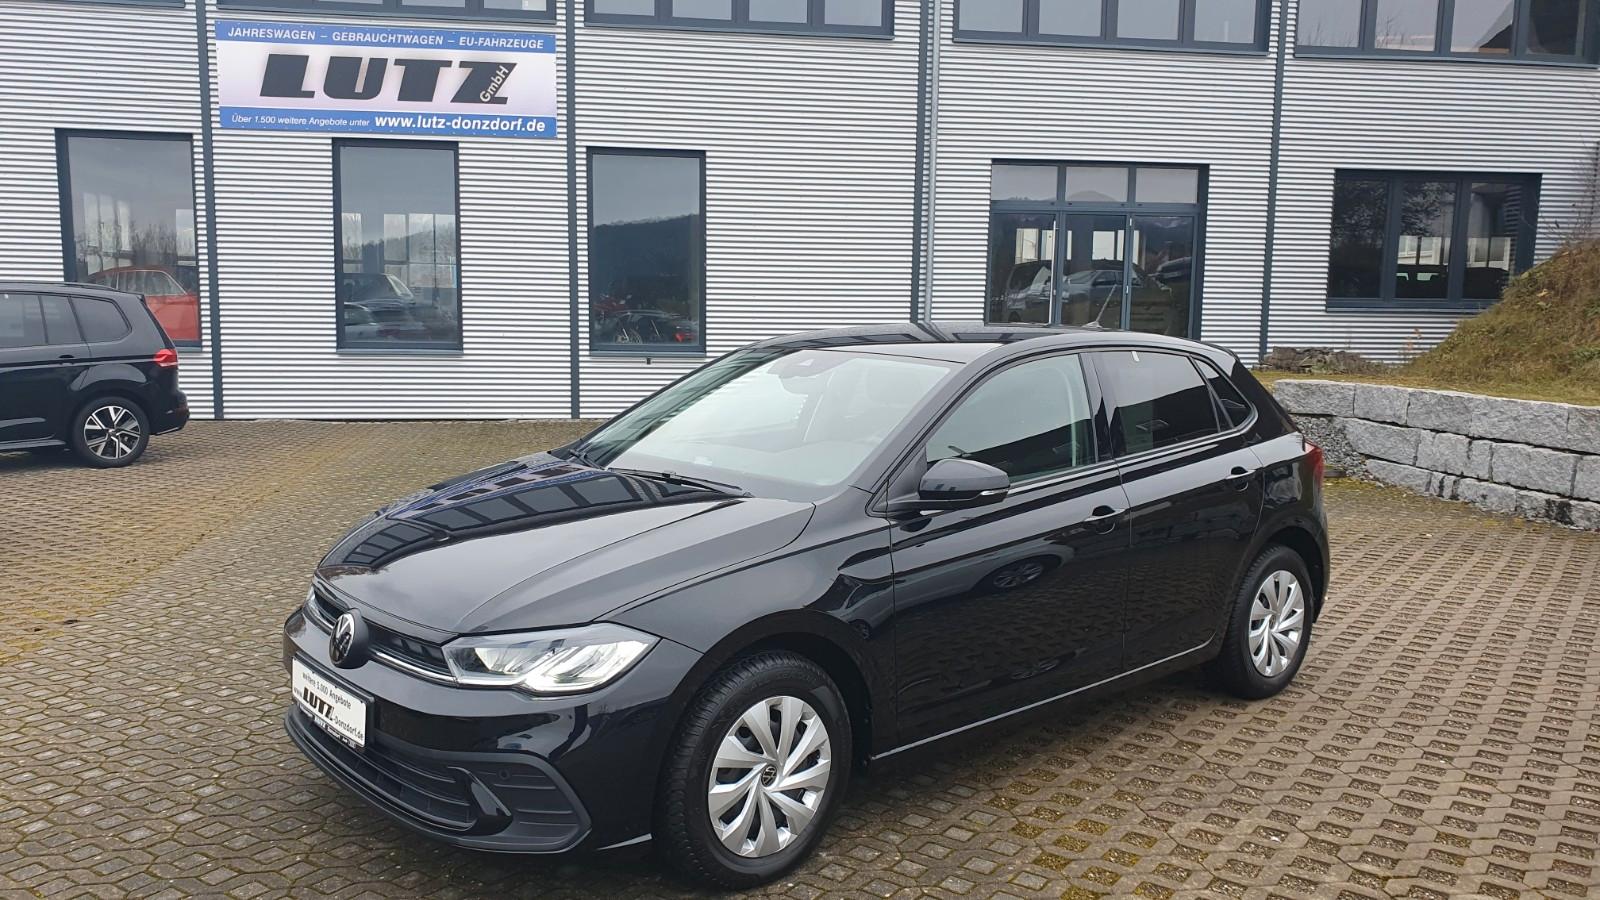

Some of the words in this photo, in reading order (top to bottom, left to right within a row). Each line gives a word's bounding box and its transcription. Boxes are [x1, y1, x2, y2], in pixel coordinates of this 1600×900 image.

[228, 27, 316, 41] JAHRESWAGEN
[332, 31, 444, 45] GEBRAUCHTWAGEN
[459, 36, 544, 49] EU-FAHRZEUGE
[260, 53, 517, 105] LUTZ
[479, 65, 509, 103] GmbH
[231, 112, 252, 123] Über
[254, 115, 276, 124] 1.500
[277, 116, 307, 125] weitere
[308, 116, 348, 127] Angebote
[349, 118, 370, 126] unter
[374, 115, 546, 132] www.lutz-donzdorf.de
[329, 689, 352, 710] Angebote
